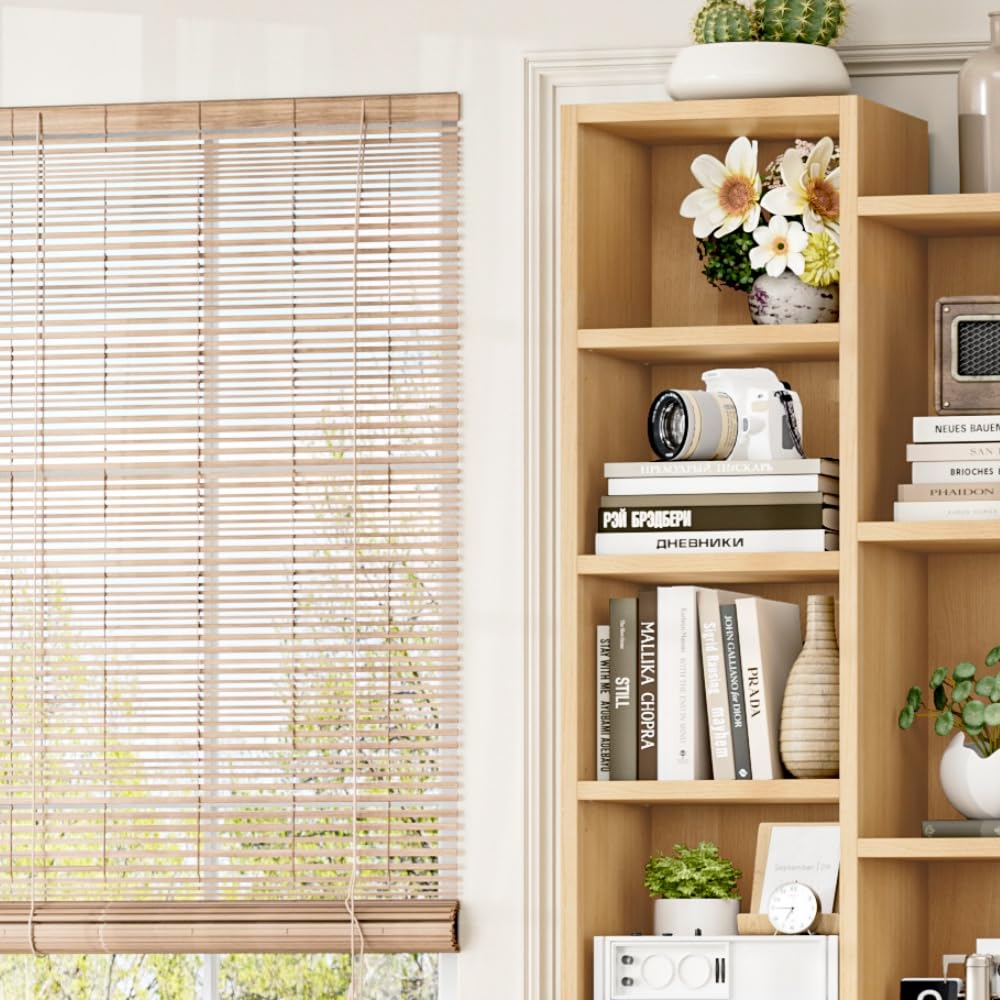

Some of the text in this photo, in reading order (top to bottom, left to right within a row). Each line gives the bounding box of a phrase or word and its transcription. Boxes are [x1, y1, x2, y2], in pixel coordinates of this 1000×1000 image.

[935, 424, 967, 433] NEUES
[970, 447, 993, 456] SAN
[950, 467, 994, 476] BRIOCHES
[929, 487, 995, 497] PHAIDON
[603, 508, 692, 529] РЭЙ БРЭДБЕРИ
[656, 538, 744, 550] ДНЕВНИКИ
[703, 622, 717, 652] Sigrid
[724, 615, 735, 641] JOHN
[600, 638, 610, 657] STAY
[600, 659, 610, 681] WITH
[726, 642, 740, 691] GALLIANO
[600, 682, 610, 695] ME
[615, 677, 630, 709] STILL
[640, 621, 655, 750] MALLIKA CHOPRA
[747, 667, 761, 718] PRADA
[732, 703, 743, 728] DIOR
[710, 706, 729, 758] mayhem
